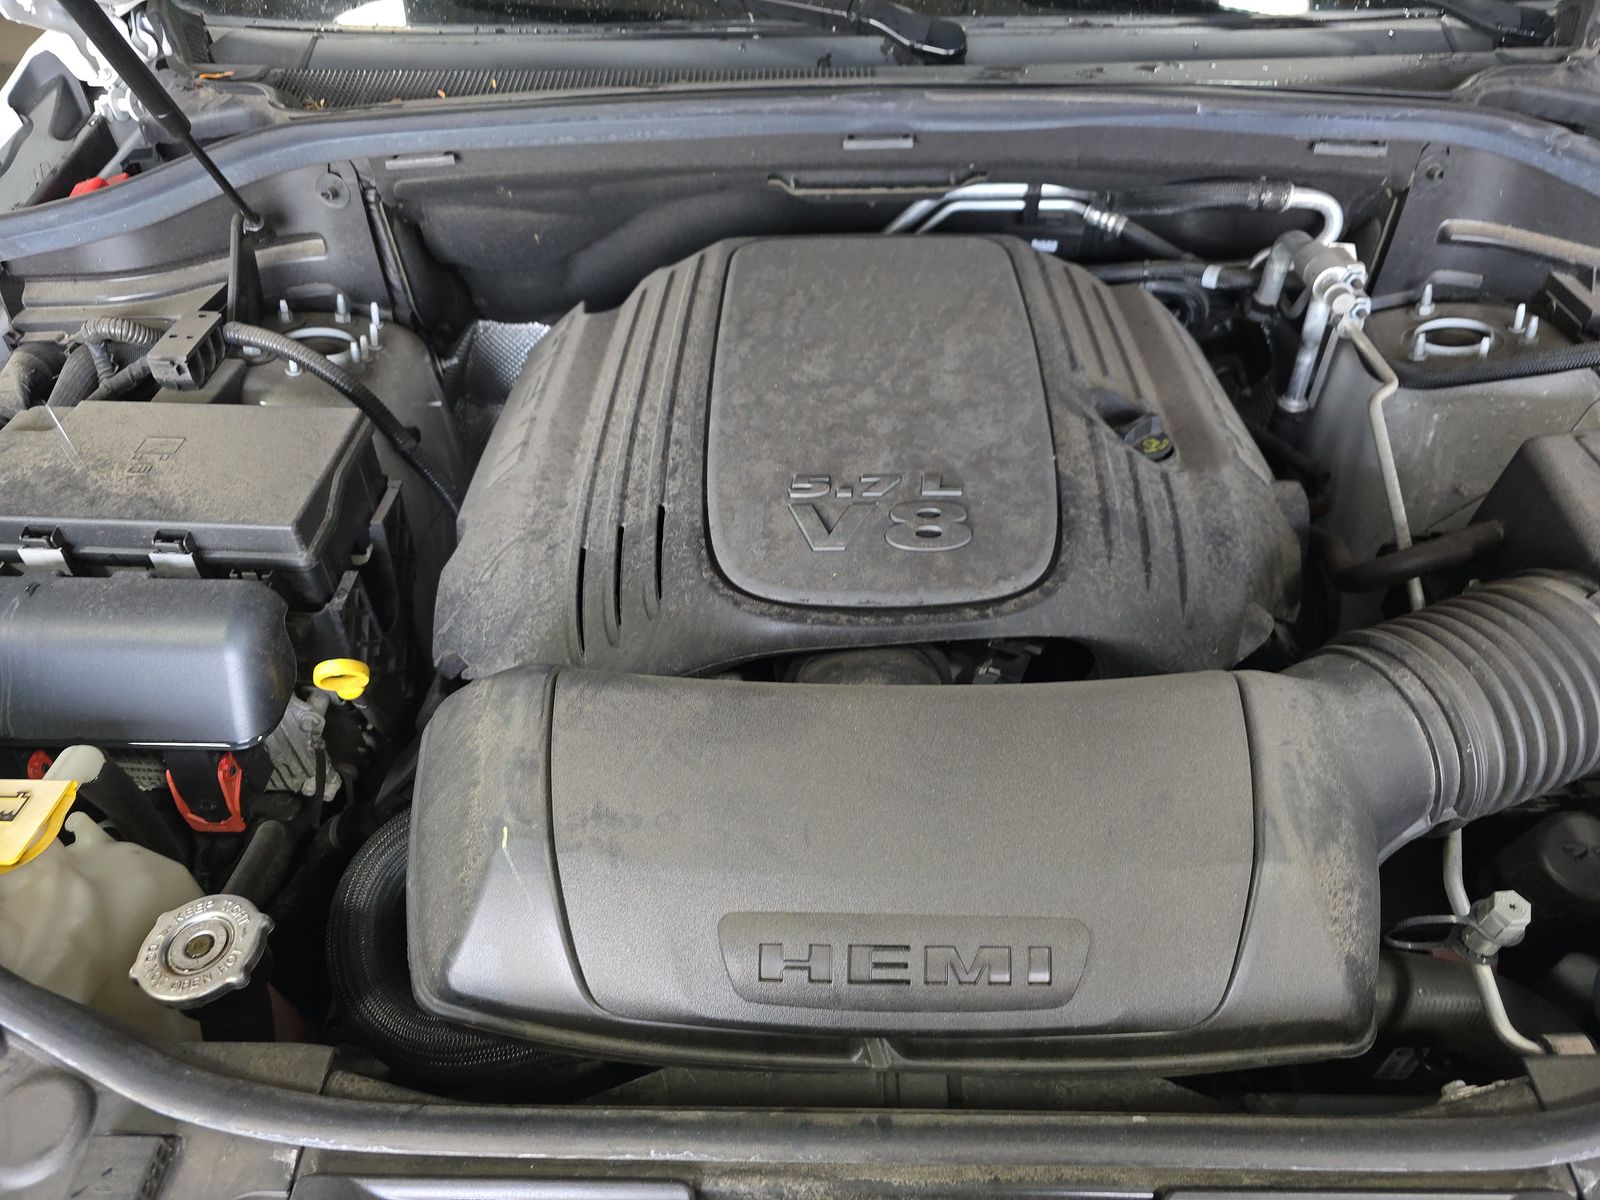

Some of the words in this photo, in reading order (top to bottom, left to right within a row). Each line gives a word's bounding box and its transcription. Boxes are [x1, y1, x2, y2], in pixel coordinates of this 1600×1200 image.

[787, 472, 903, 499] 5.7
[787, 500, 974, 552] V8
[174, 900, 215, 925] KEEP
[170, 972, 213, 992] OPEN
[217, 947, 243, 977] HOT
[758, 942, 1053, 986] HEMI
